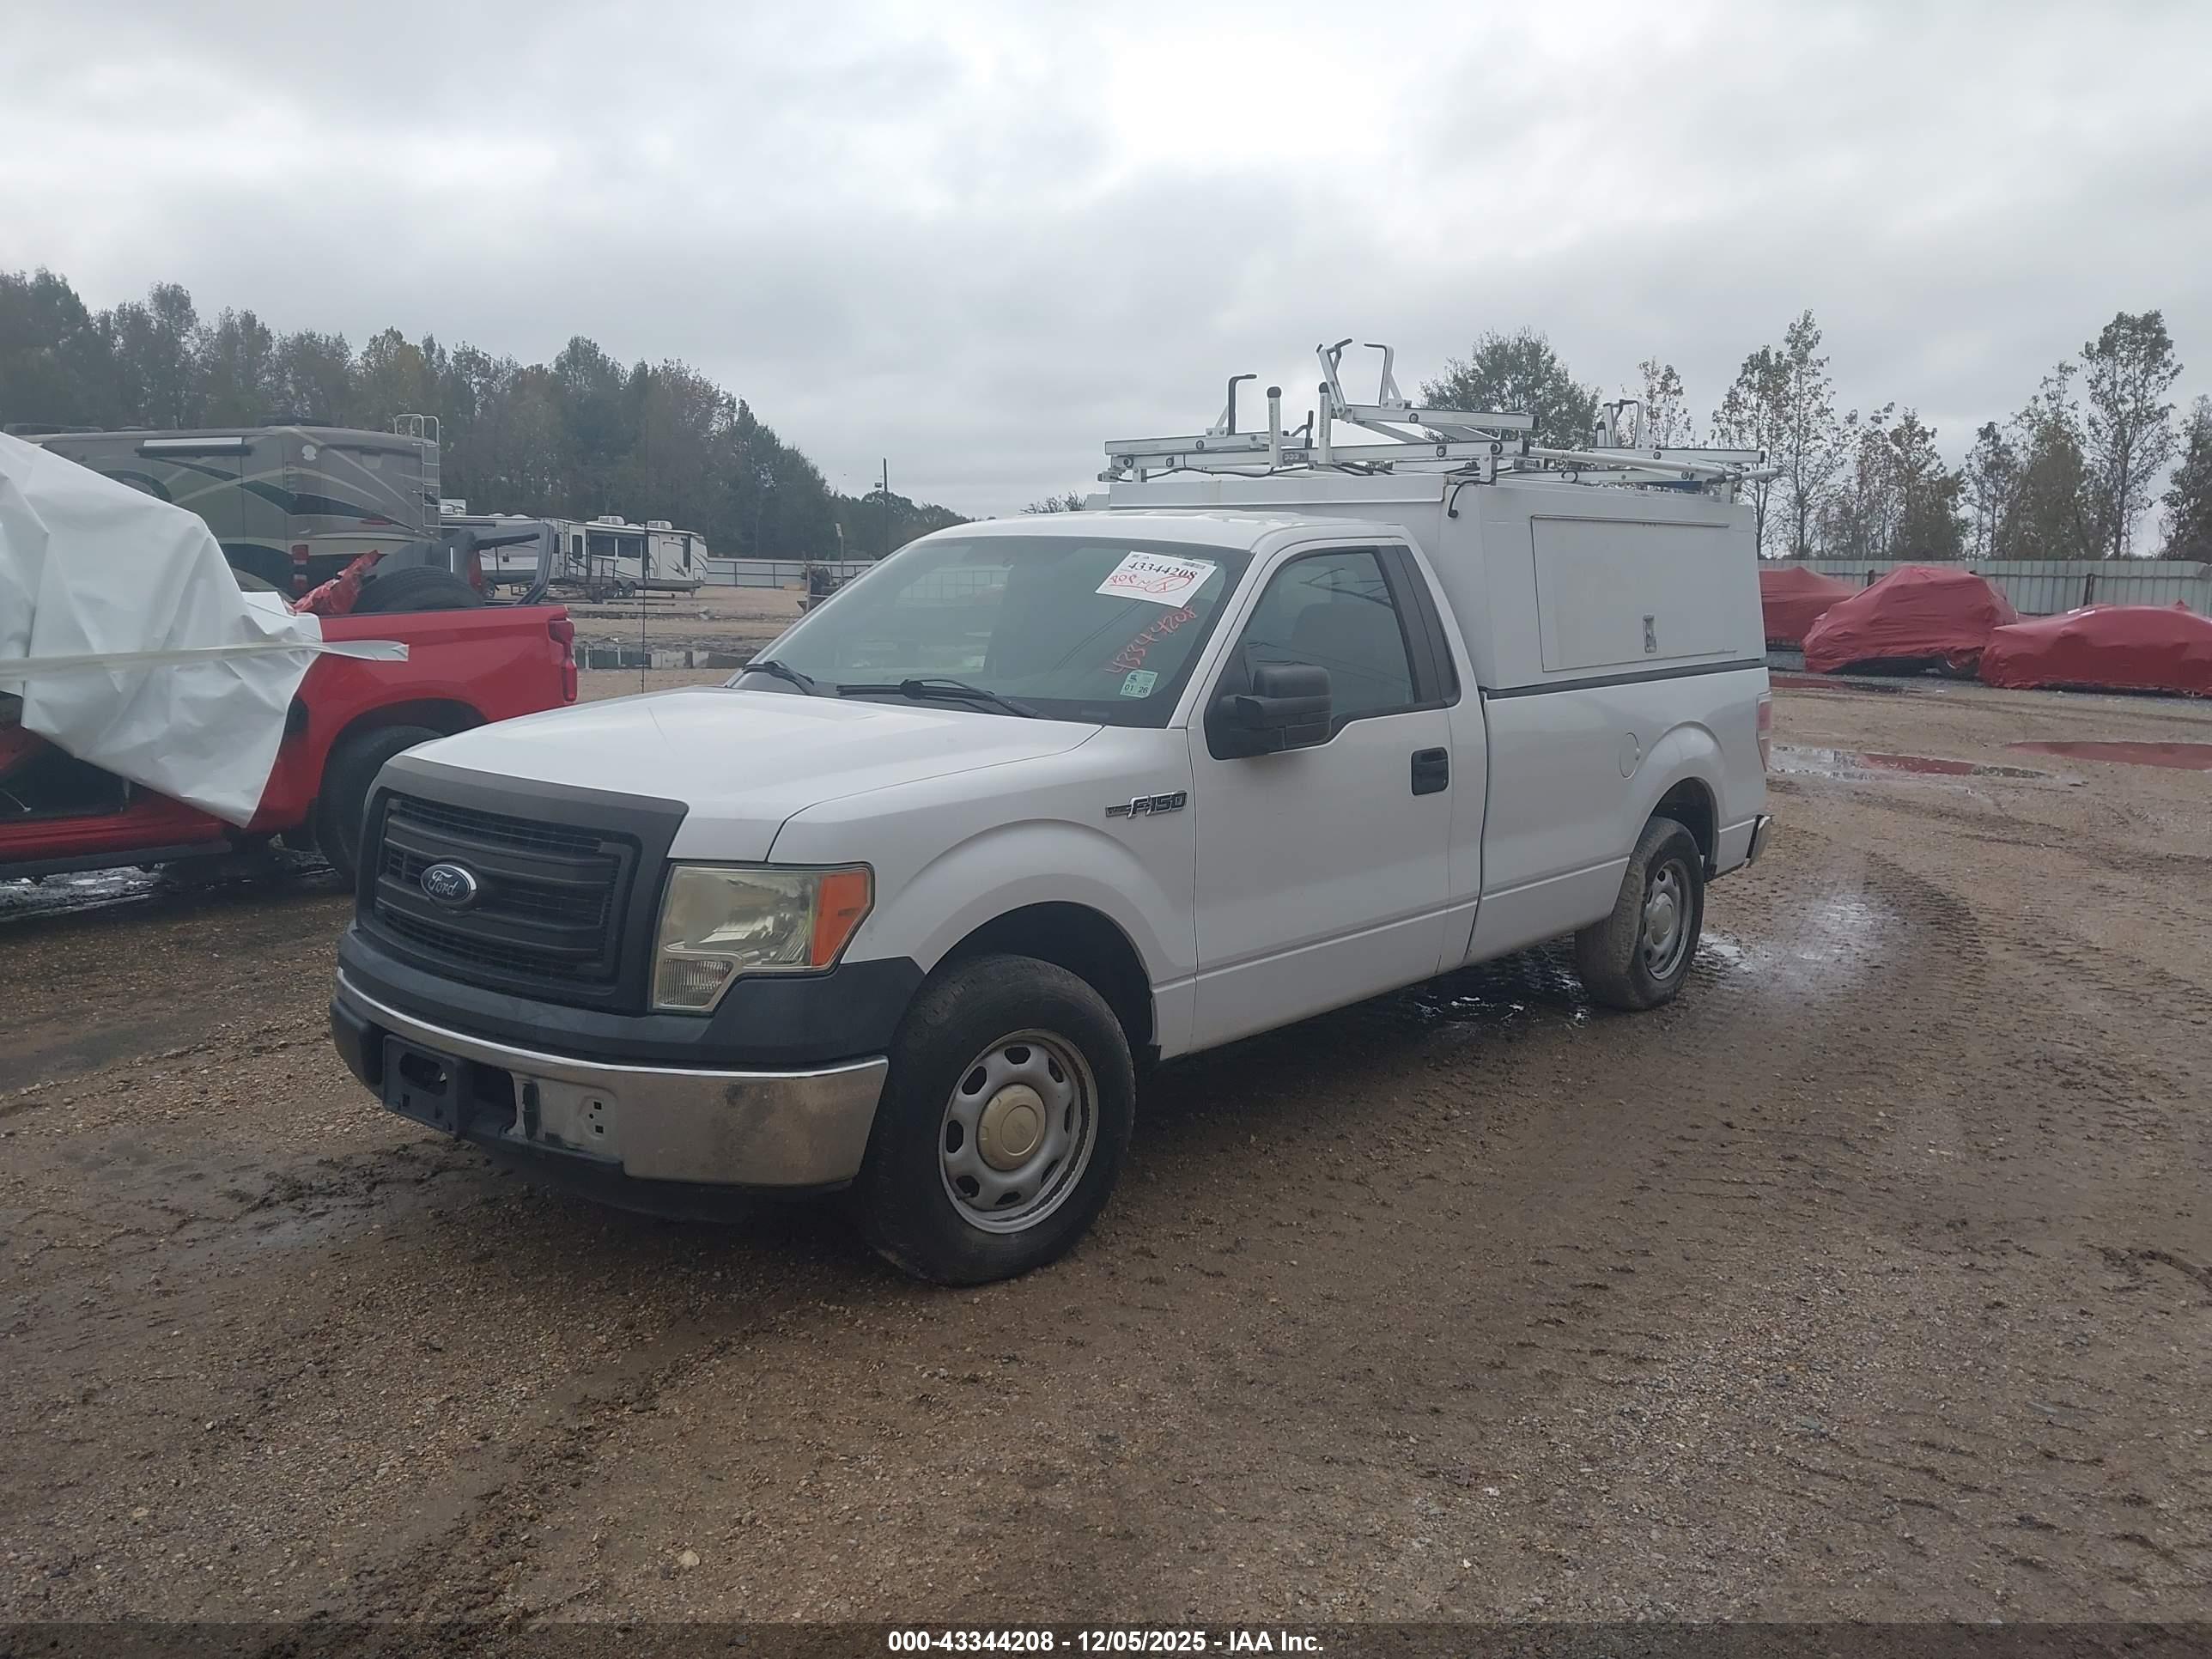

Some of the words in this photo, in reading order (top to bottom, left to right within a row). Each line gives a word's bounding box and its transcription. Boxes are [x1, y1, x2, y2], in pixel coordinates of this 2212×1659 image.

[1127, 561, 1199, 579] 43344208
[1105, 605, 1198, 673] 43344208
[428, 870, 459, 896] Ford
